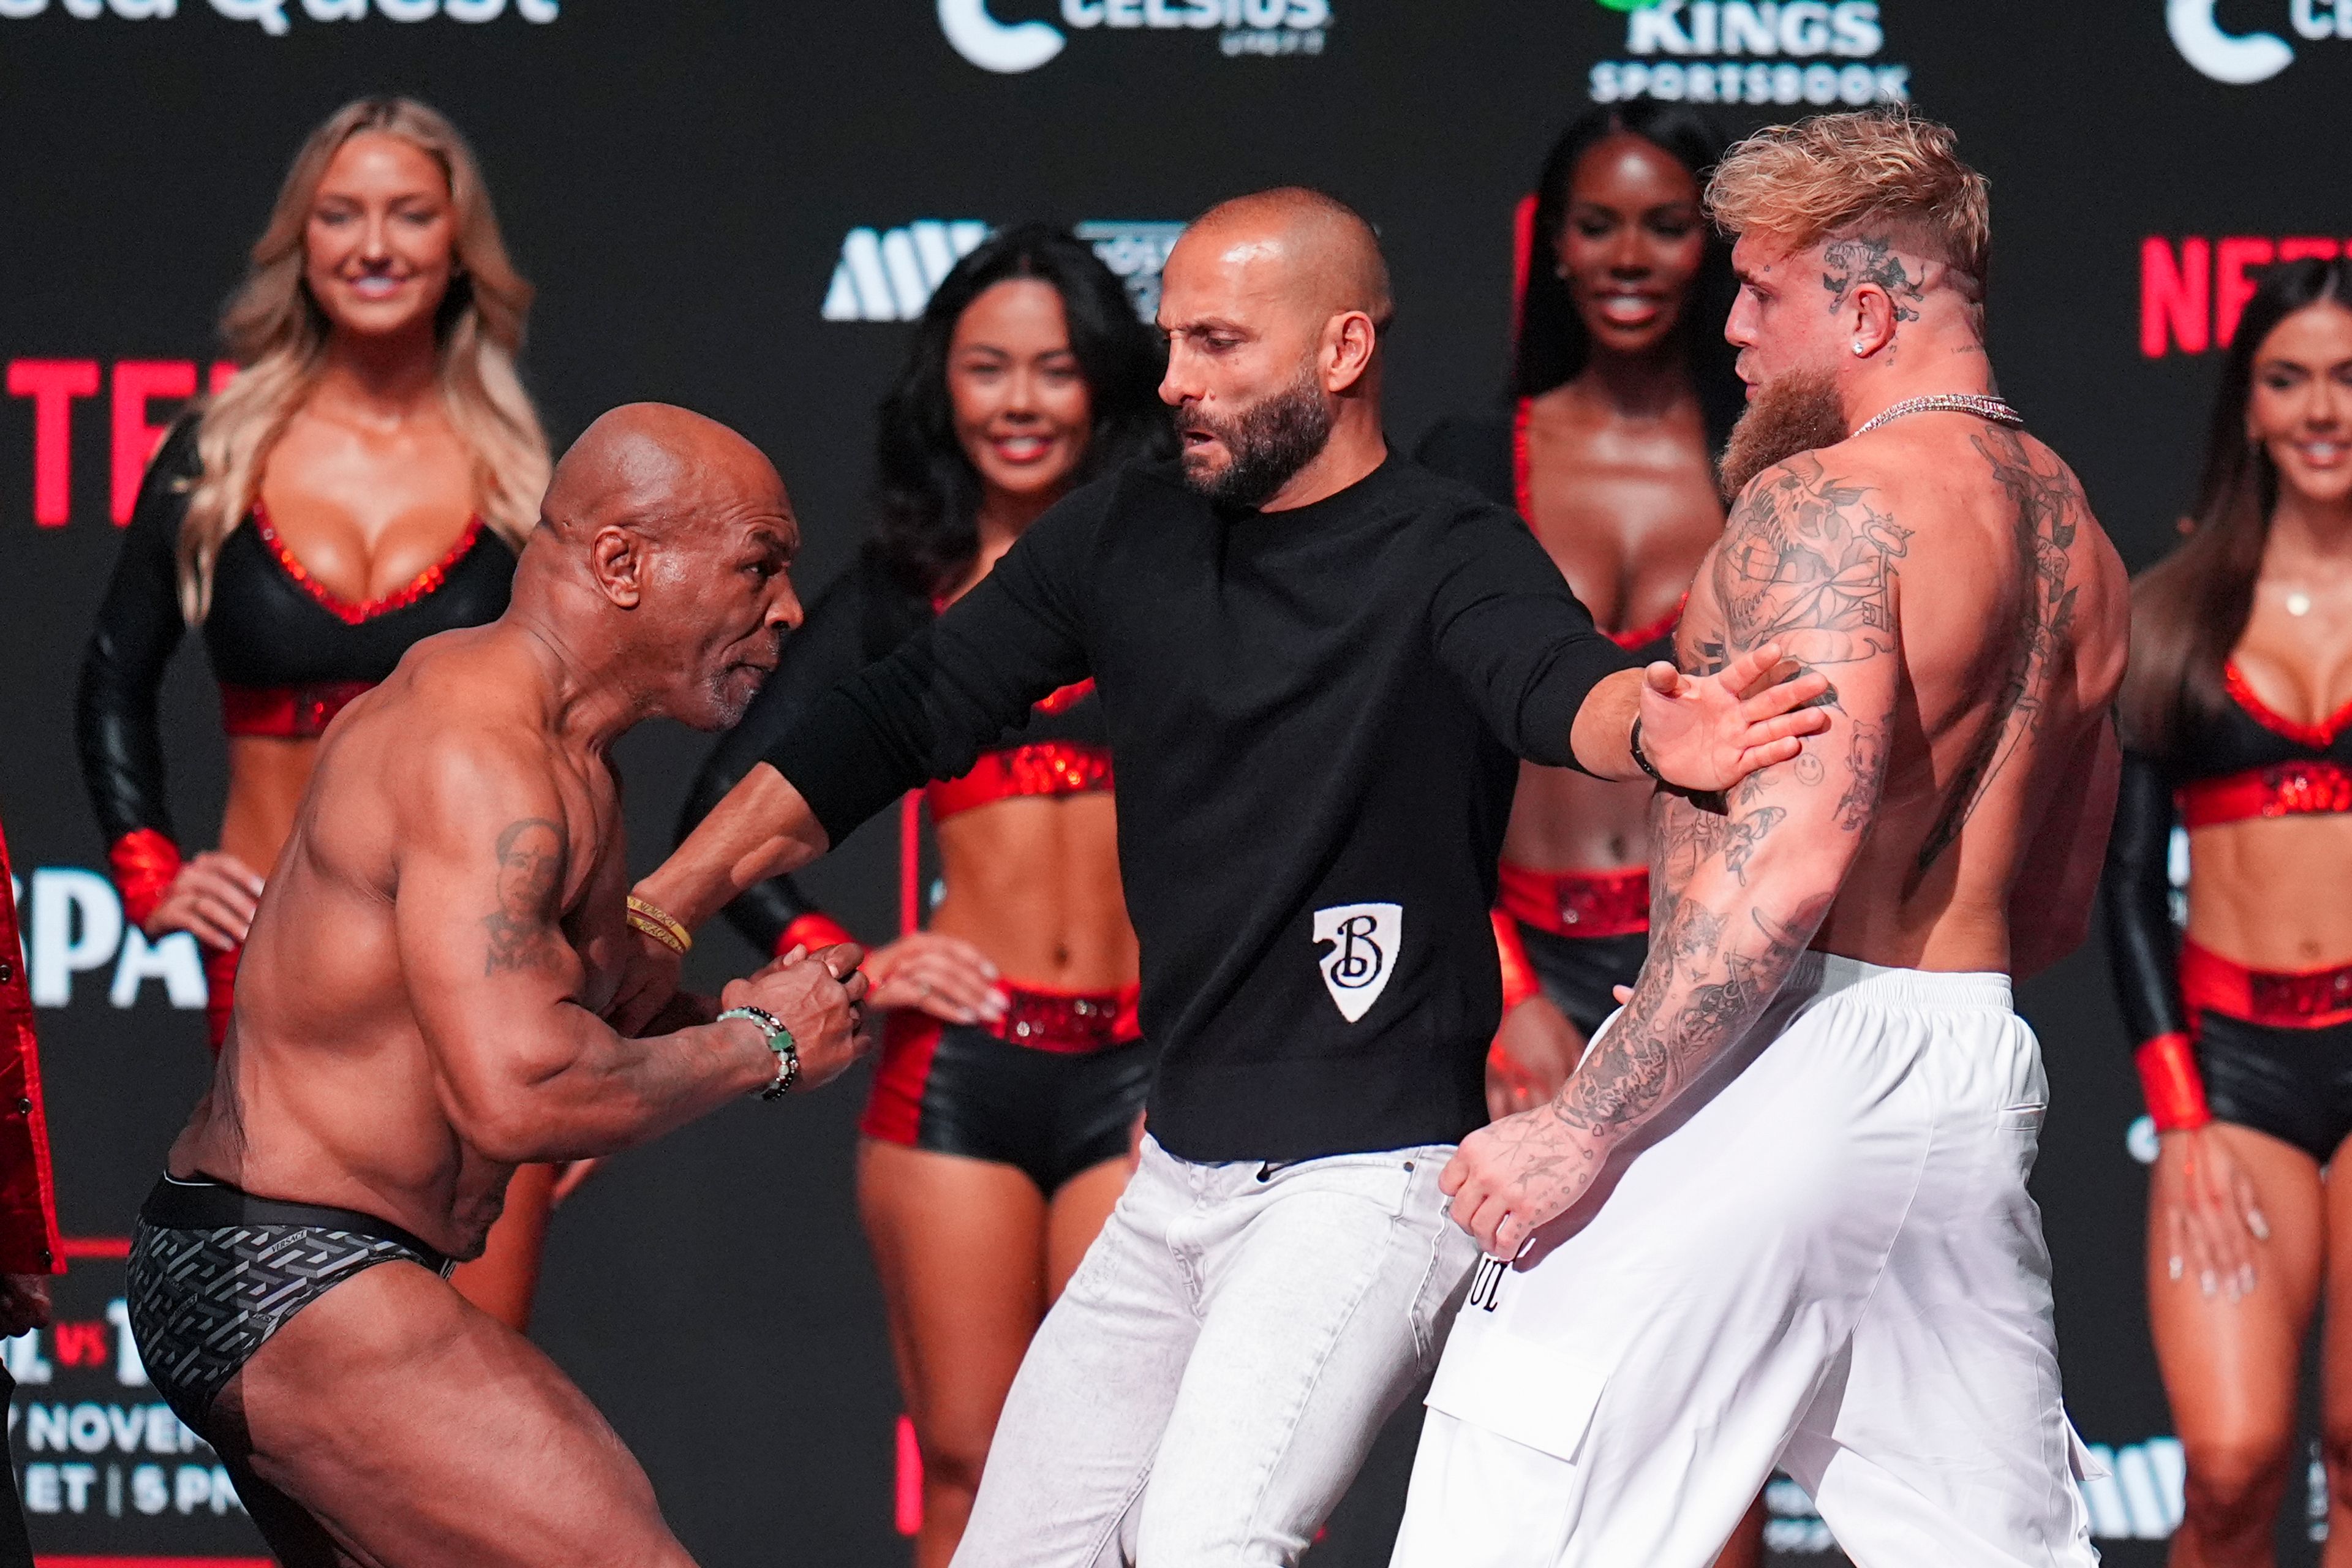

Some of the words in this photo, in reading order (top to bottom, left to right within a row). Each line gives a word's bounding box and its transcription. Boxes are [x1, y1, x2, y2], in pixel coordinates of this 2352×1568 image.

[1626, 0, 1885, 57] KINGS
[1589, 62, 1911, 105] SPORTSBOOK
[10, 865, 209, 1009] PA
[26, 1463, 97, 1514] ET
